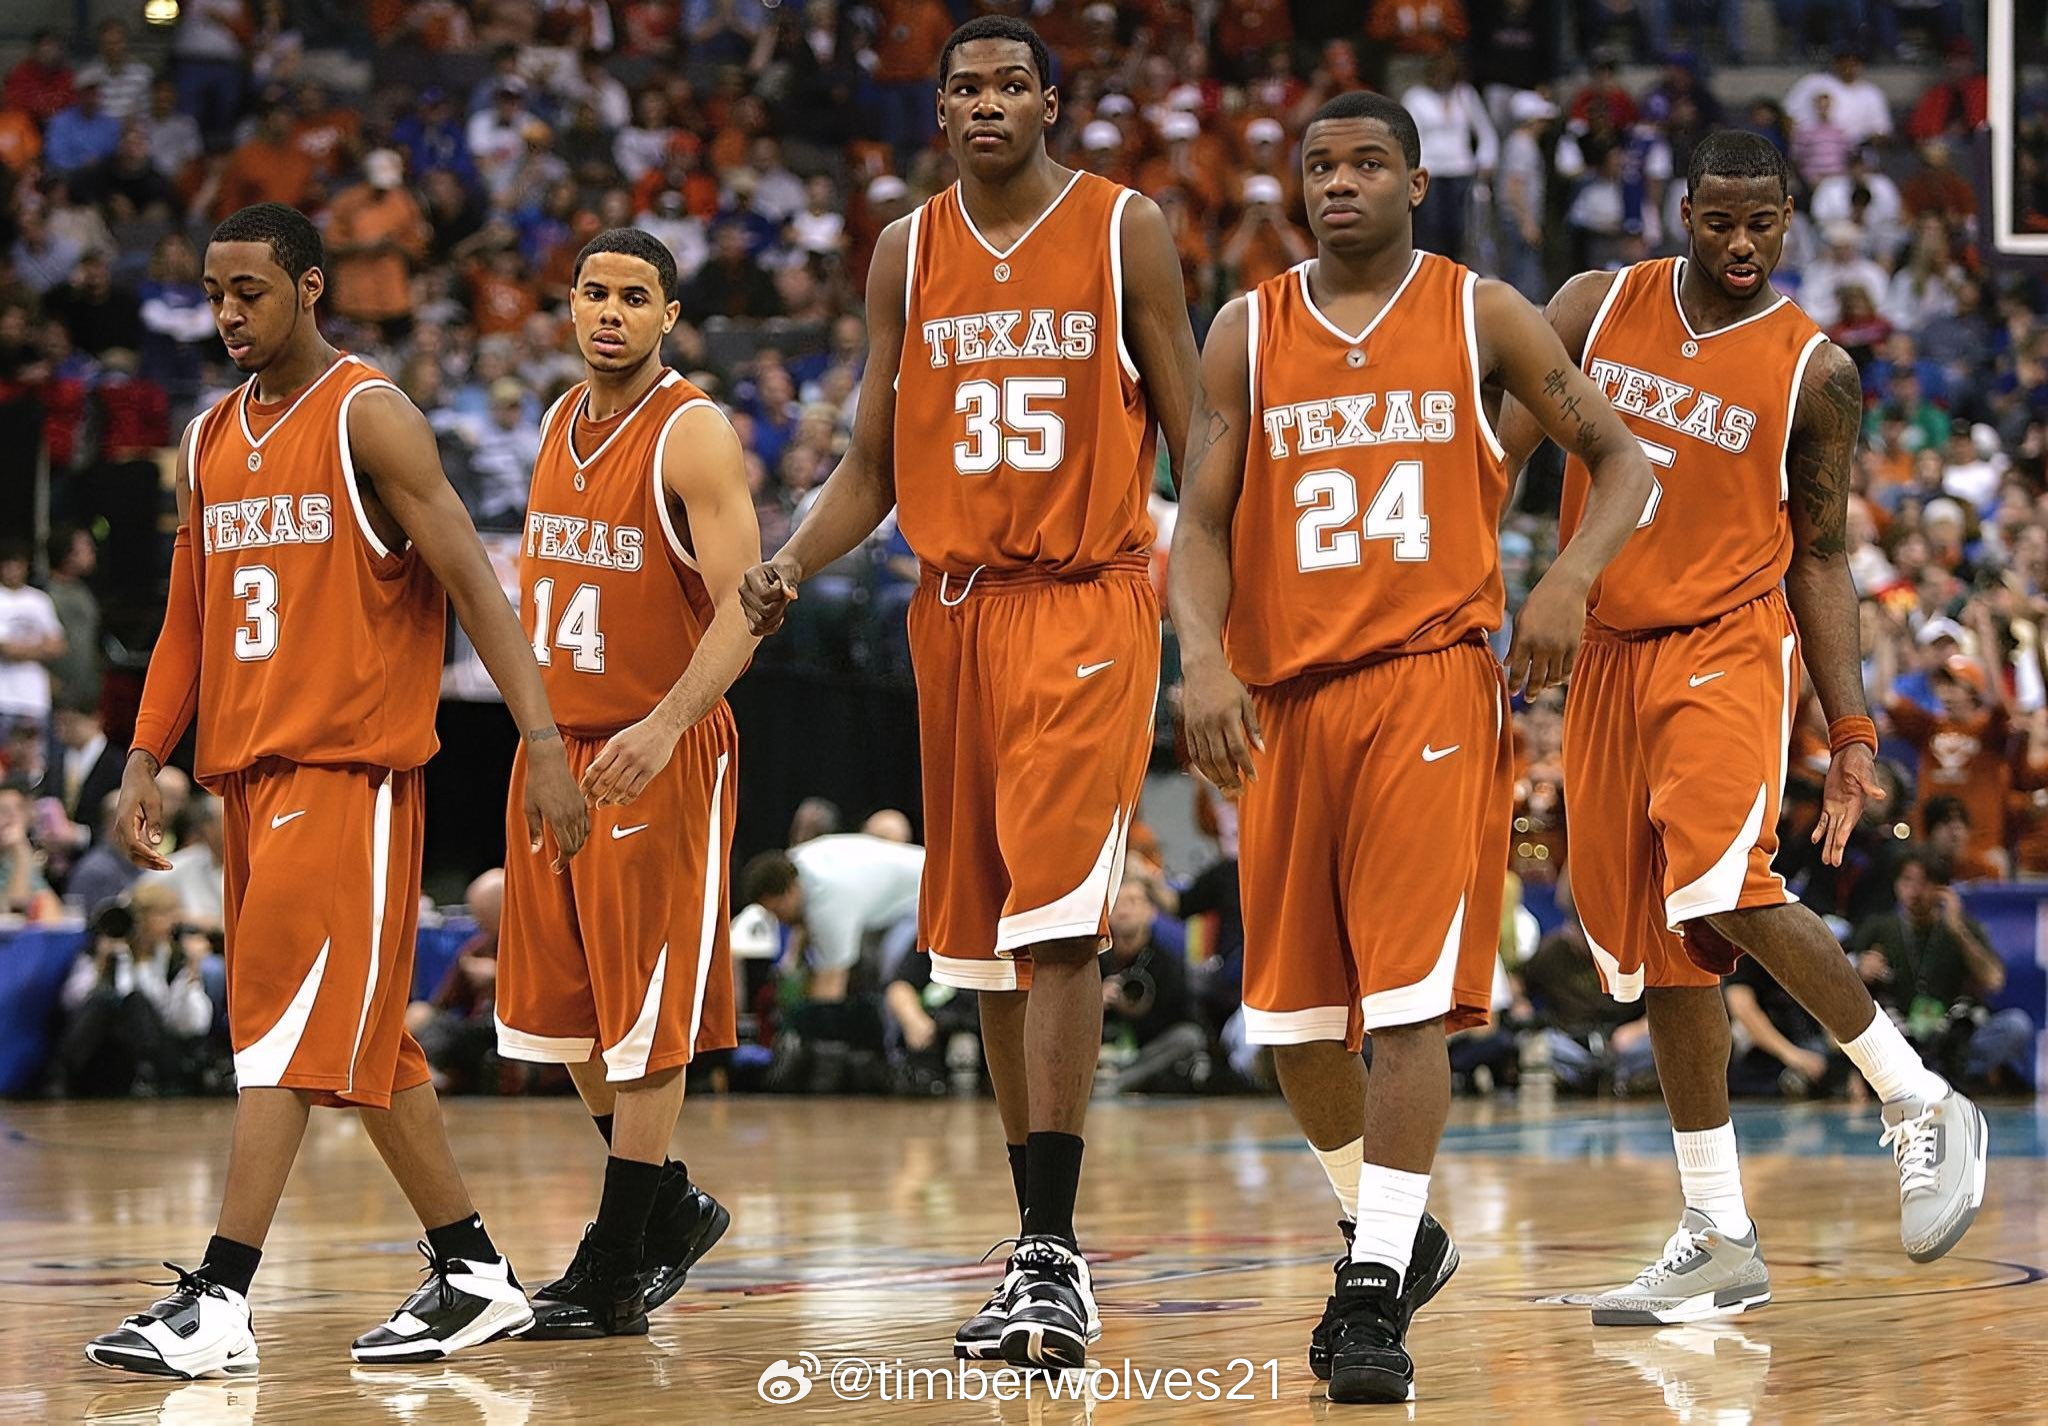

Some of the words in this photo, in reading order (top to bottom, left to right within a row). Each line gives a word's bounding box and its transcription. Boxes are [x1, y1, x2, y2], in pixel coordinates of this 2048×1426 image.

[922, 309, 1096, 369] TEXAS
[953, 377, 1067, 476] 35
[1263, 390, 1456, 460] TEXAS
[1590, 357, 1757, 454] TEXAS
[1293, 460, 1431, 574] 24
[233, 564, 279, 662] 3
[531, 577, 606, 674] 14
